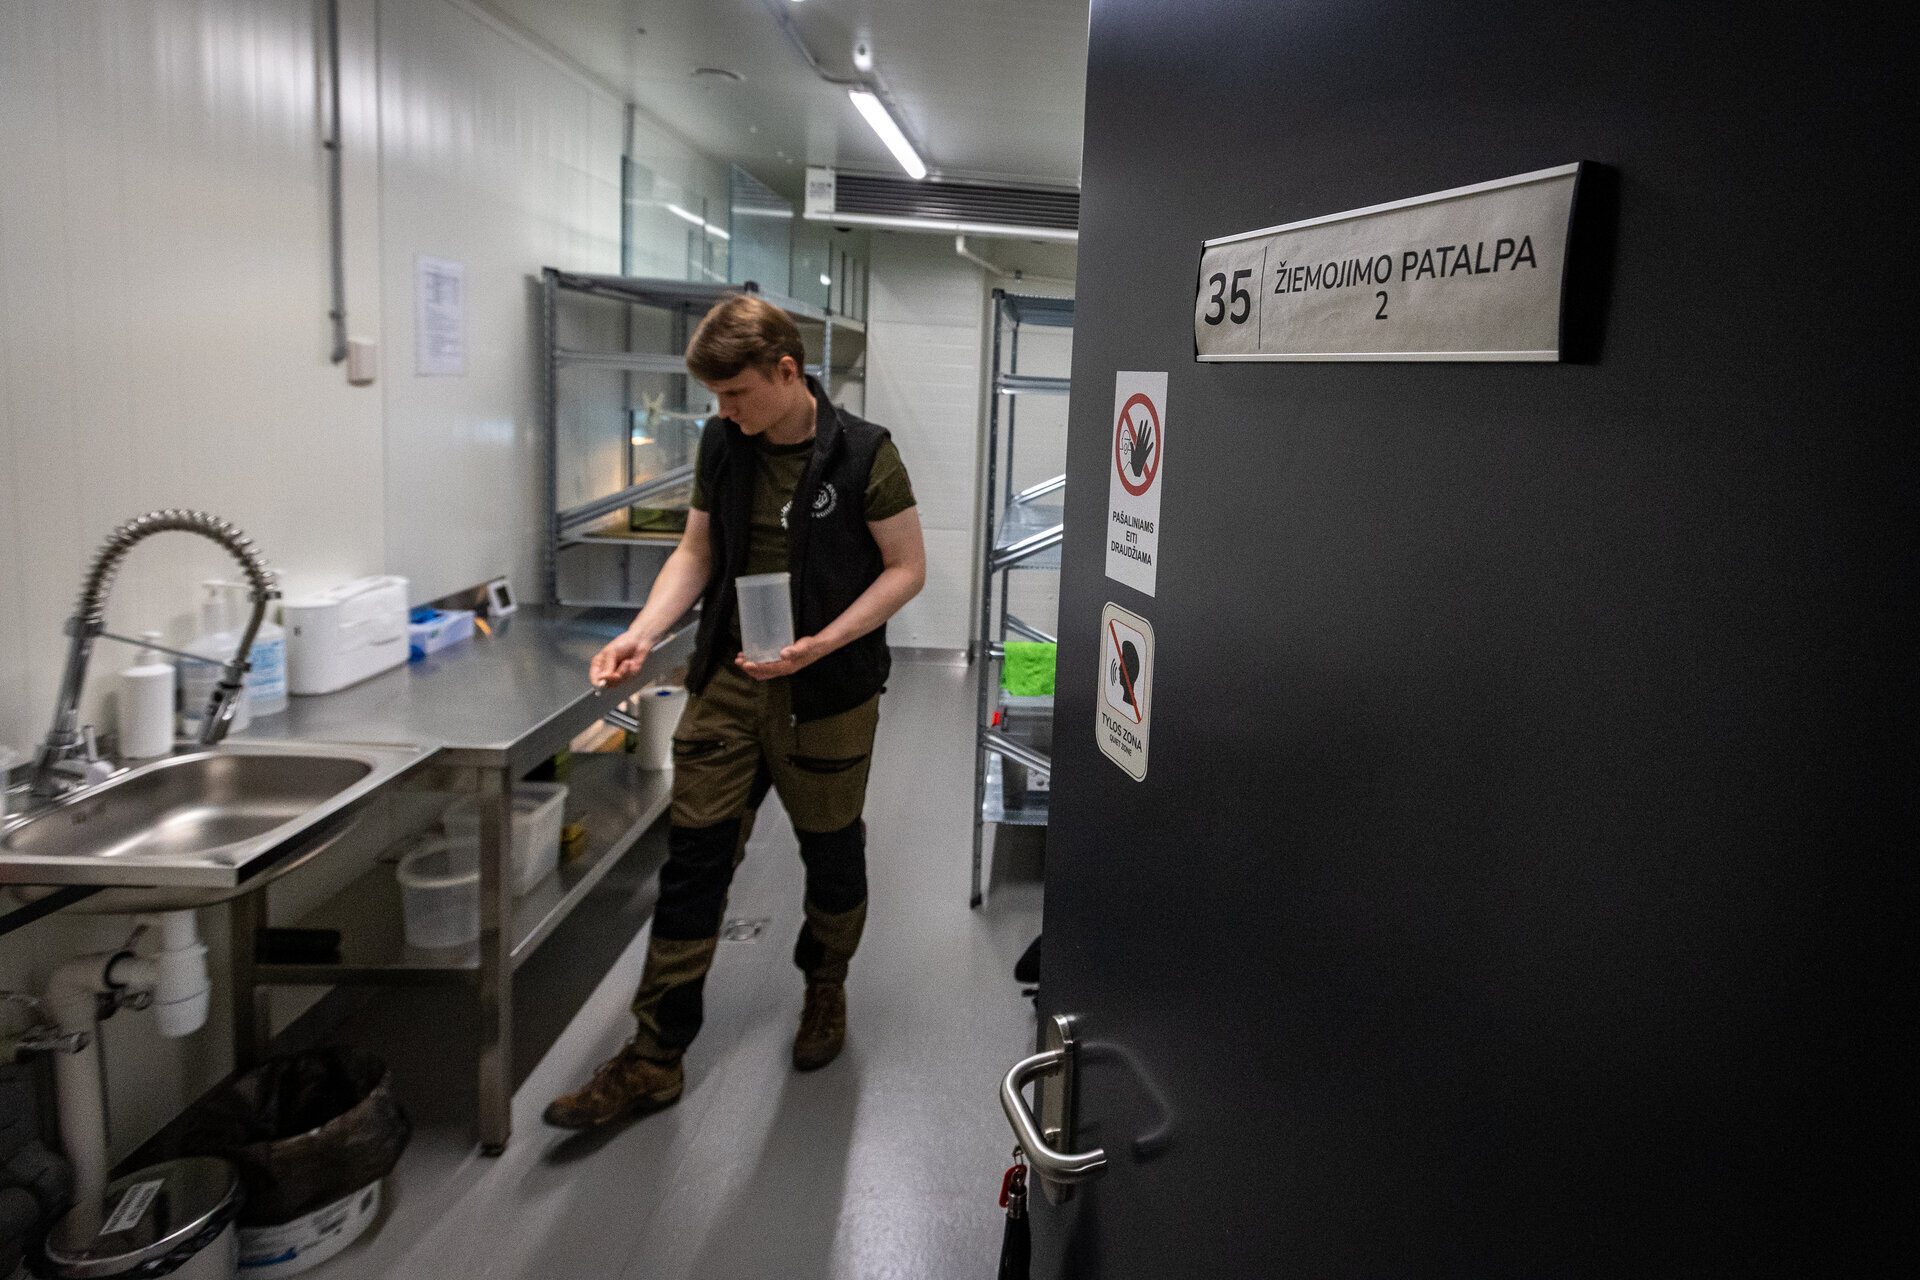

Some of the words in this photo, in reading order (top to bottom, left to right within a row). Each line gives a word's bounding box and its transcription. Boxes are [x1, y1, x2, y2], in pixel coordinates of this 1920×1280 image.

[1274, 255, 1393, 295] ŽIEMOJIMO
[1401, 235, 1537, 282] PATALPA
[1204, 269, 1252, 326] 35
[1375, 291, 1388, 320] 2
[1112, 510, 1154, 534] PAŠALINIAMS
[1125, 530, 1138, 544] EITI
[1111, 540, 1152, 566] DRAUDŽIAMA
[1102, 711, 1122, 737] TYLOS
[1122, 728, 1142, 753] ZONA
